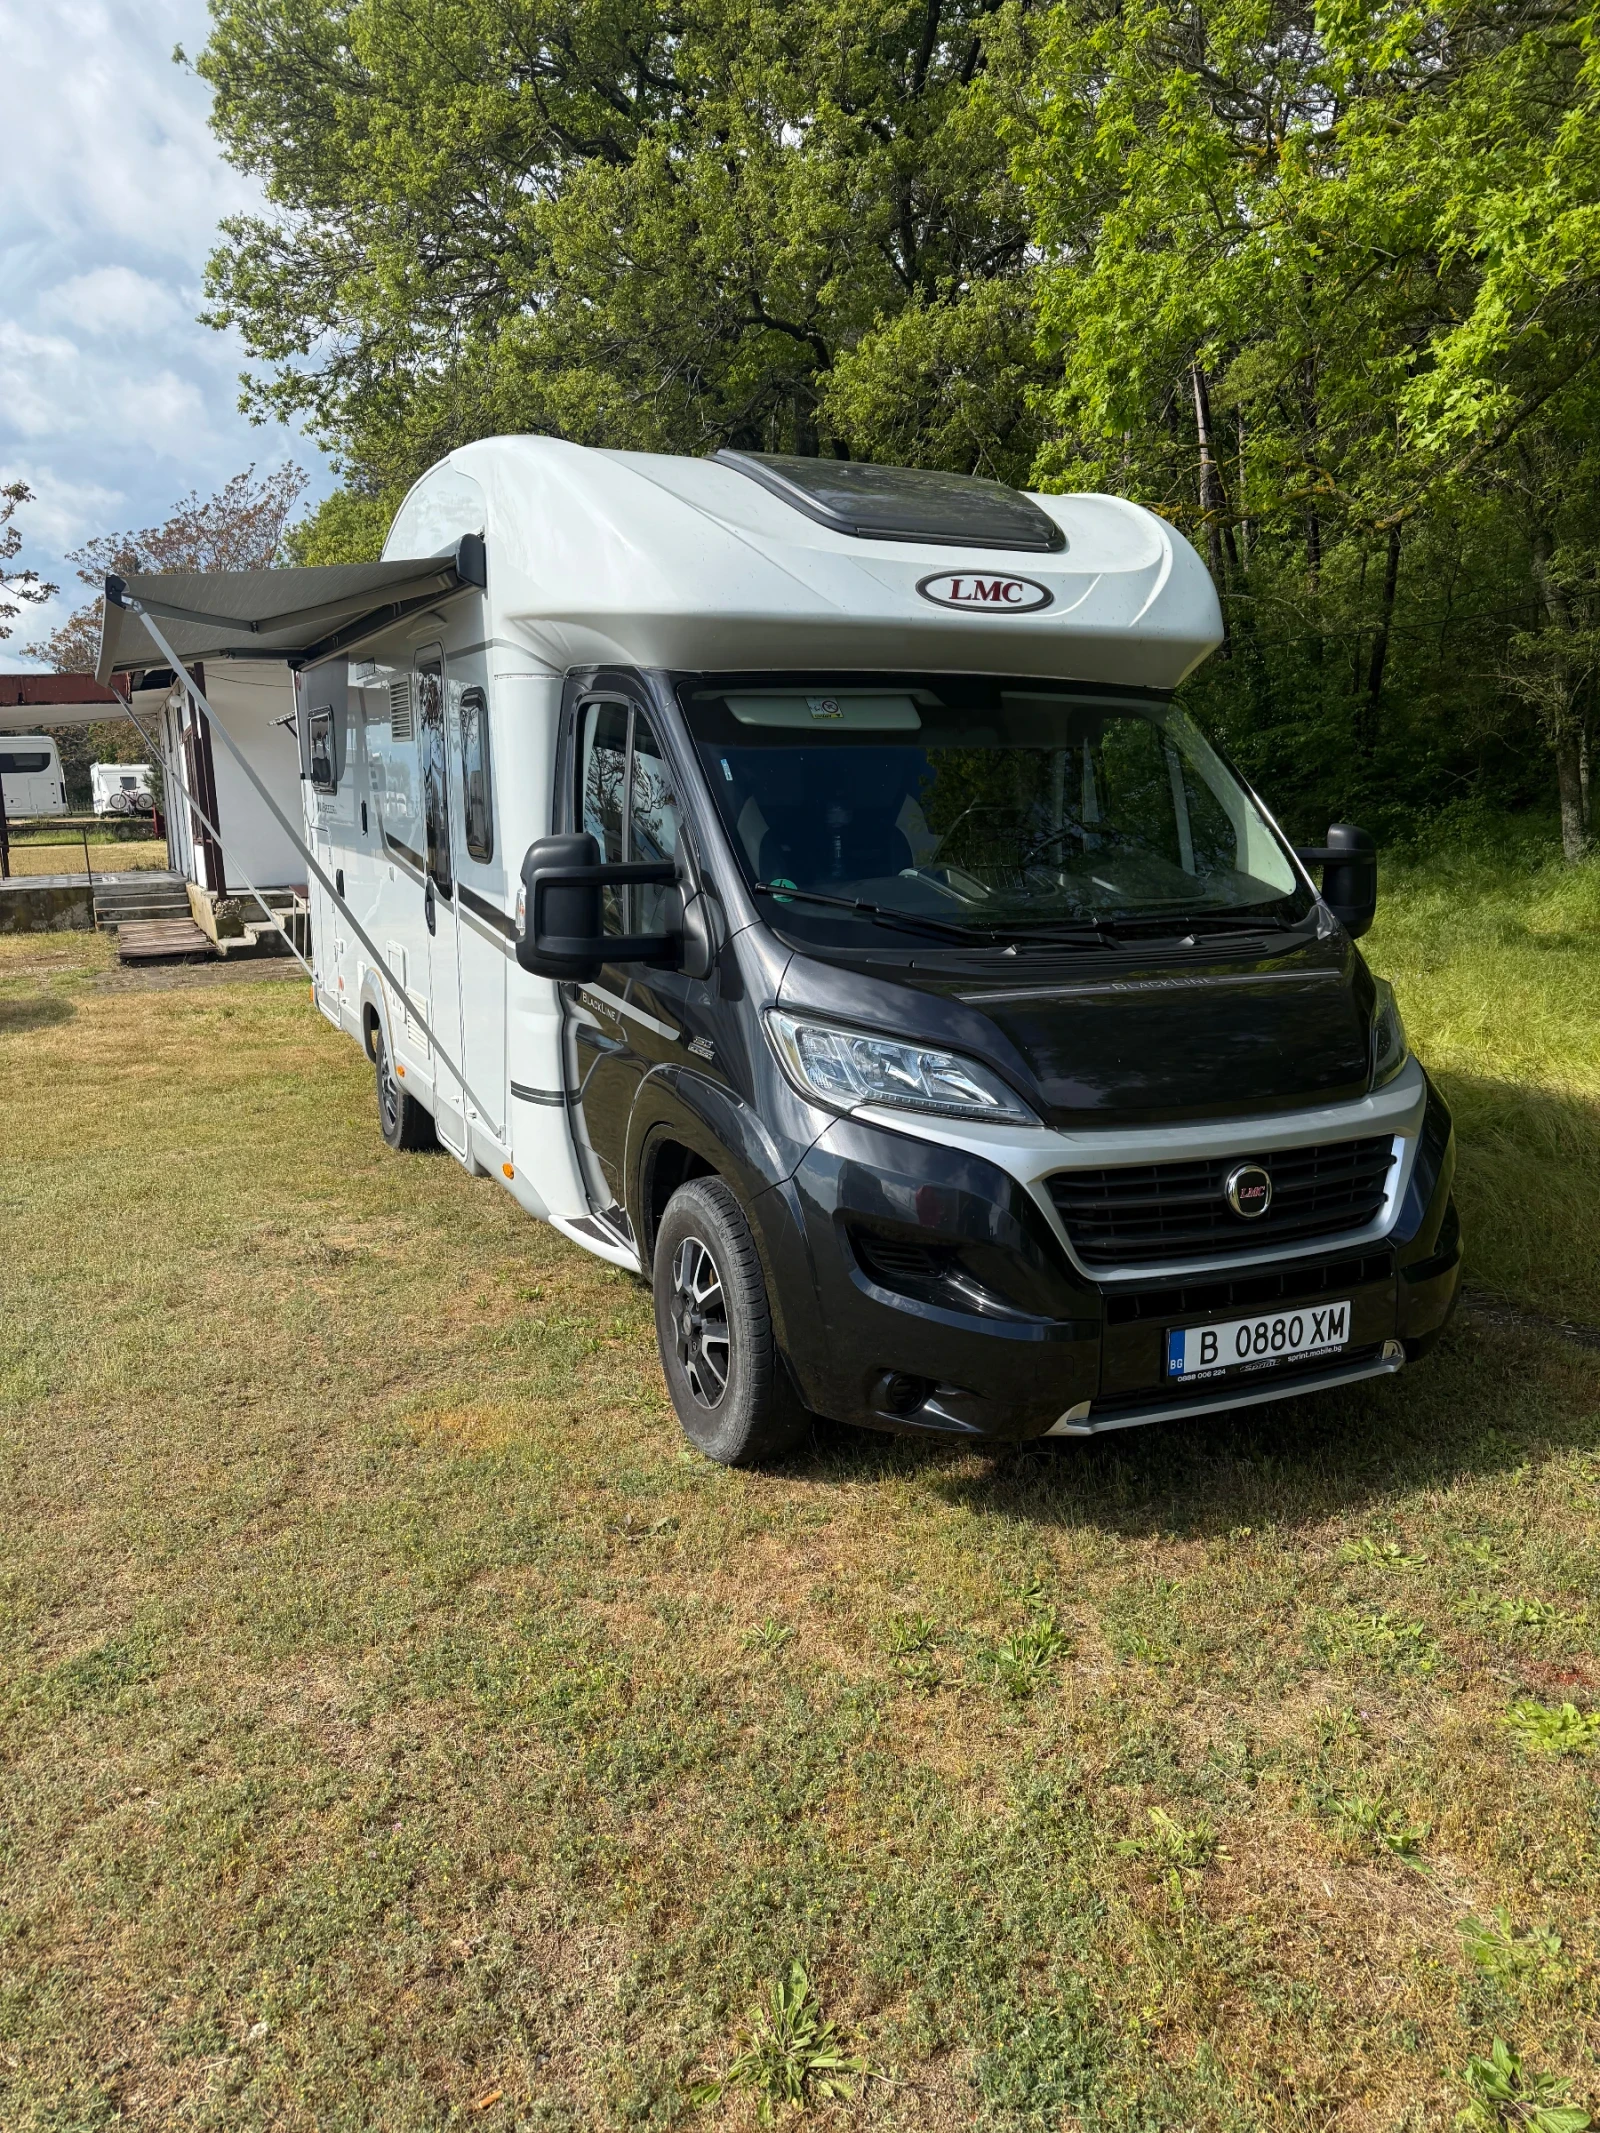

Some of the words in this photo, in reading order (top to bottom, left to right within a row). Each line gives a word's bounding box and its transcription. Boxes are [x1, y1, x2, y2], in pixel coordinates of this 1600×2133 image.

[948, 578, 1024, 603] LMC
[1239, 1185, 1266, 1199] LMC
[1200, 1331, 1219, 1365] B
[1235, 1315, 1304, 1358] 0880
[1309, 1306, 1346, 1345] XM
[1287, 1345, 1342, 1362] sprint.mobile.bg
[1170, 1358, 1183, 1370] BG
[1213, 1368, 1227, 1377] 224
